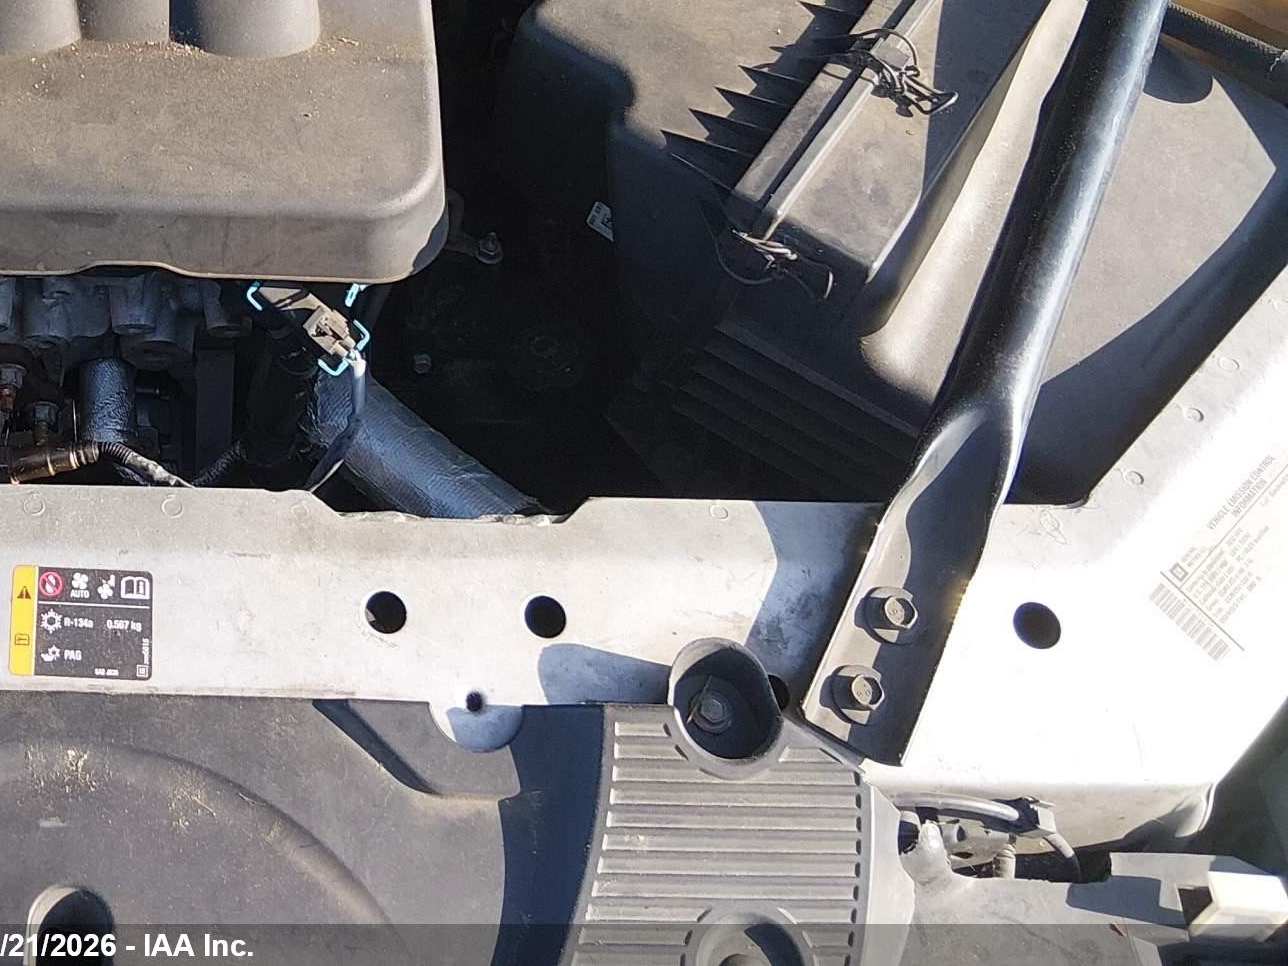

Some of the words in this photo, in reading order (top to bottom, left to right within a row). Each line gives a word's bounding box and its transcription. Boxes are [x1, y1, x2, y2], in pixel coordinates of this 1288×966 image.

[1206, 504, 1230, 531] VEHICLE
[1227, 478, 1253, 507] EMISSION
[1249, 454, 1276, 481] CONTROL
[1231, 477, 1268, 518] INFORMATION
[70, 589, 90, 599] AUTO
[63, 617, 94, 629] R-134a
[130, 620, 143, 633] kg
[63, 649, 82, 662] PAG
